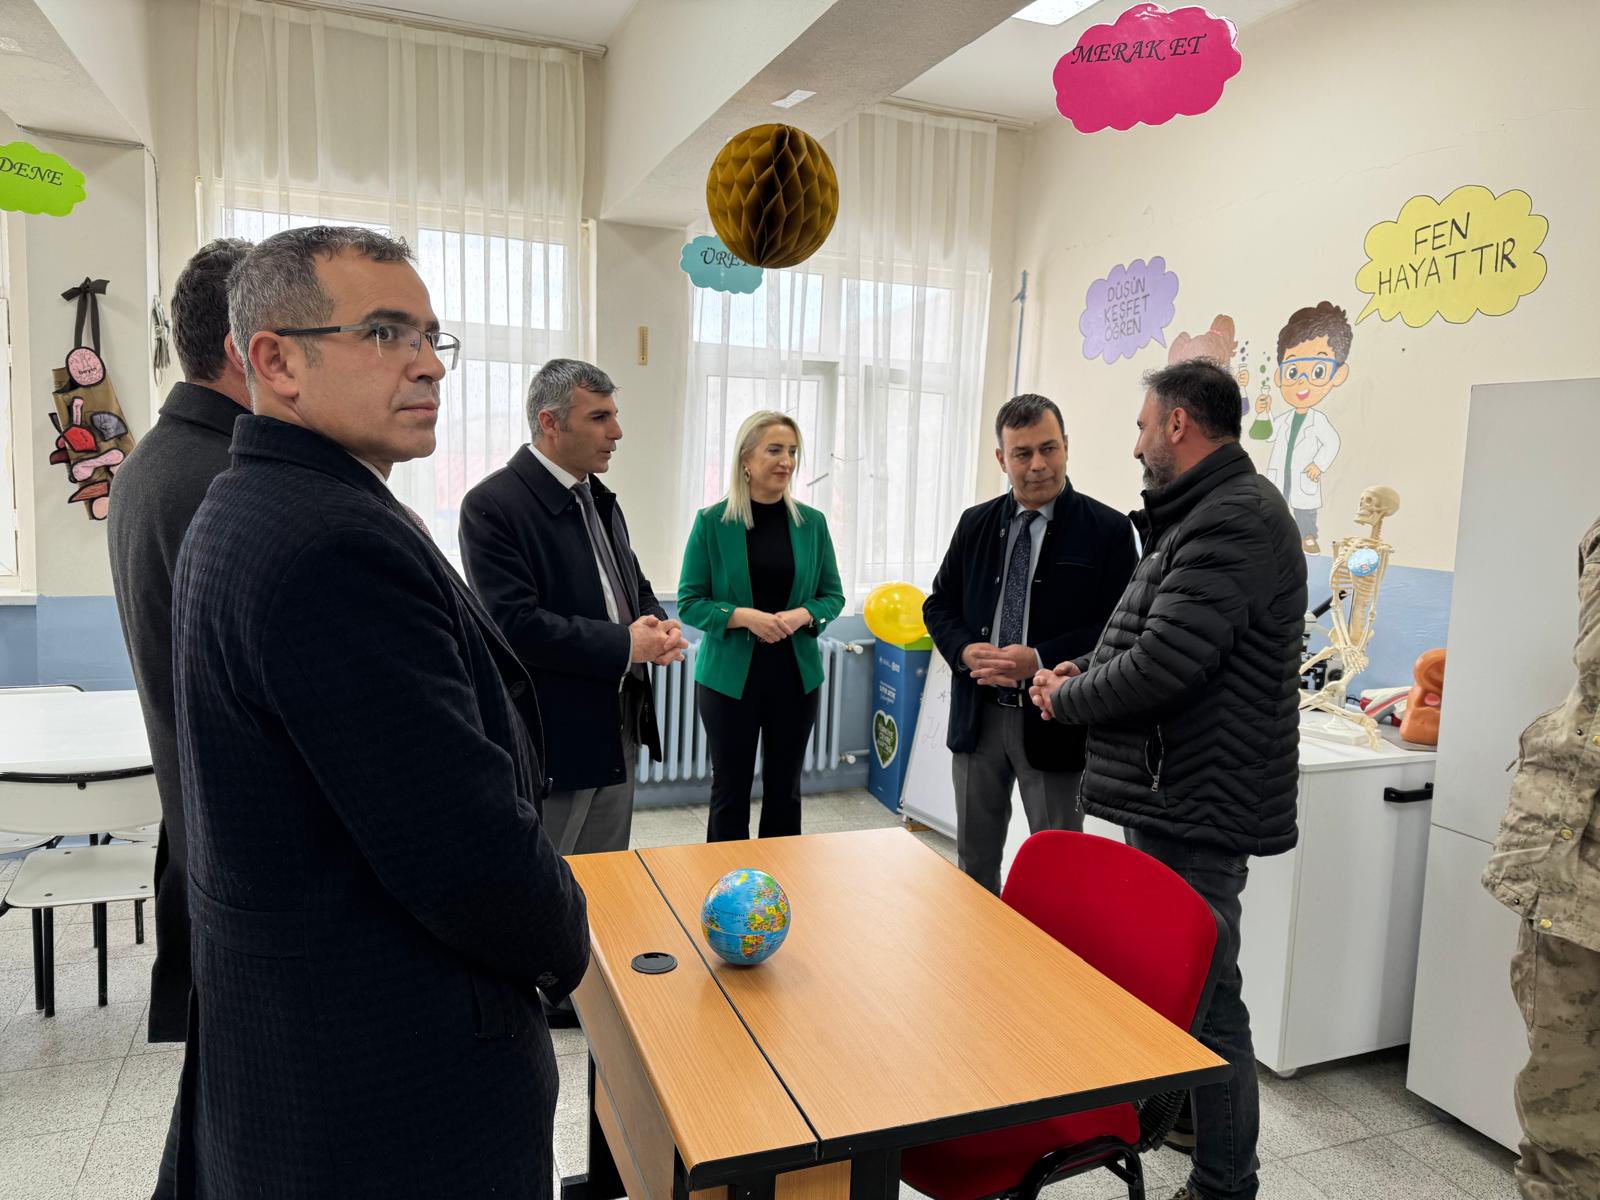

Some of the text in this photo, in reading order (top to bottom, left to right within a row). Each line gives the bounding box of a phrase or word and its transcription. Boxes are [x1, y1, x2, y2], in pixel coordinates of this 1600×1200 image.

[1071, 33, 1207, 64] MERAK ET
[0, 156, 64, 186] DENE
[1414, 211, 1470, 255] FEN
[700, 247, 748, 269] ÜRE
